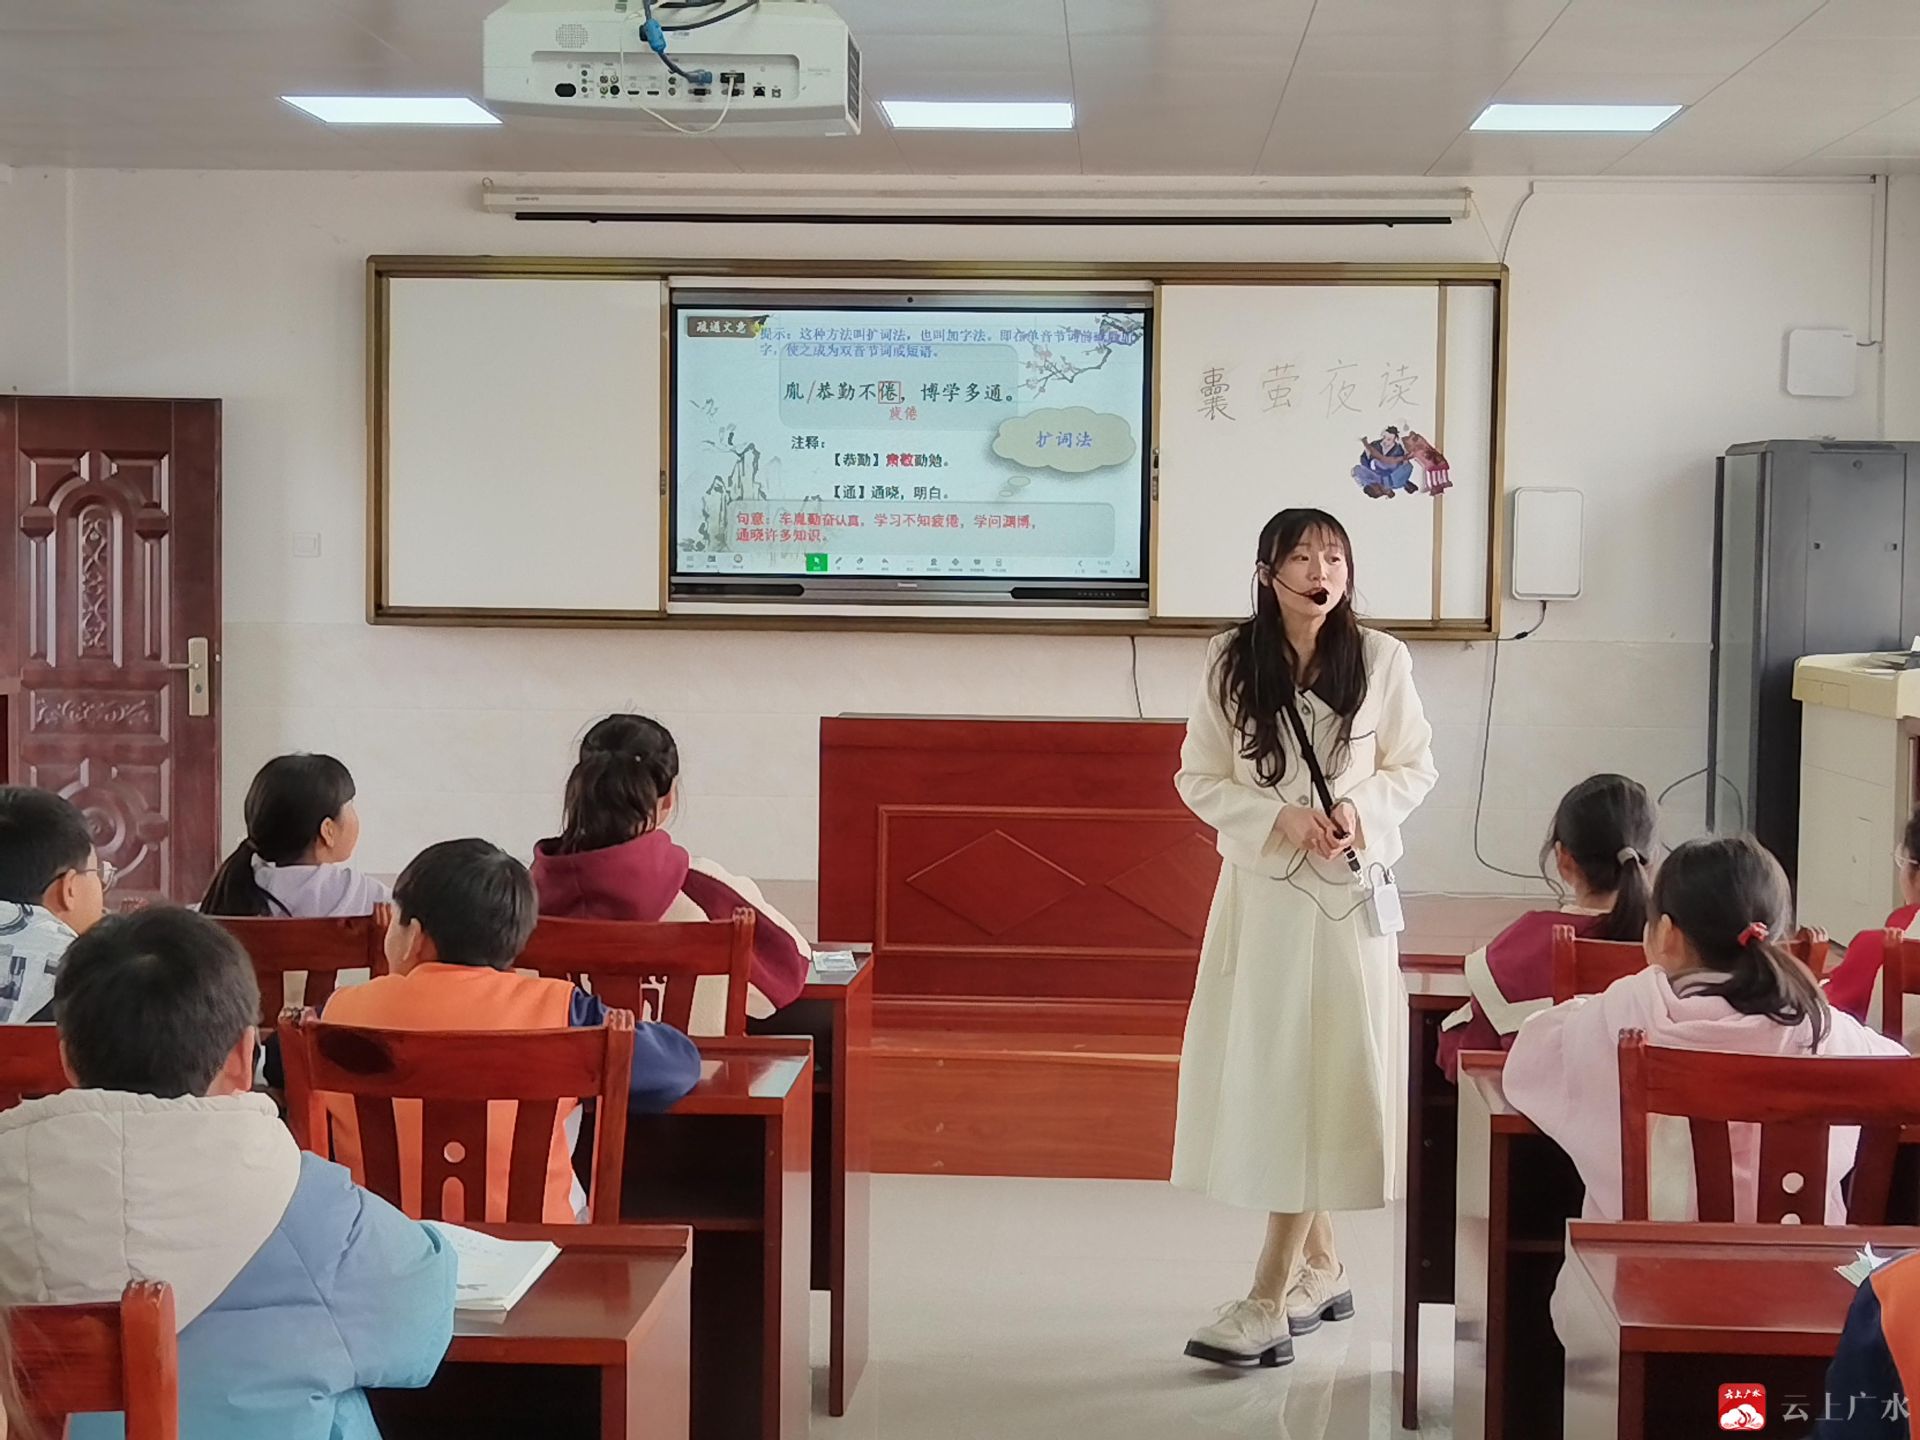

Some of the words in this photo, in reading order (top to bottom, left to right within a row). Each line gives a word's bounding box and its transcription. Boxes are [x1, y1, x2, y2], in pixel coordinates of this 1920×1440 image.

[1197, 359, 1419, 421] 囊萤夜读
[1035, 431, 1093, 448] 扩词法
